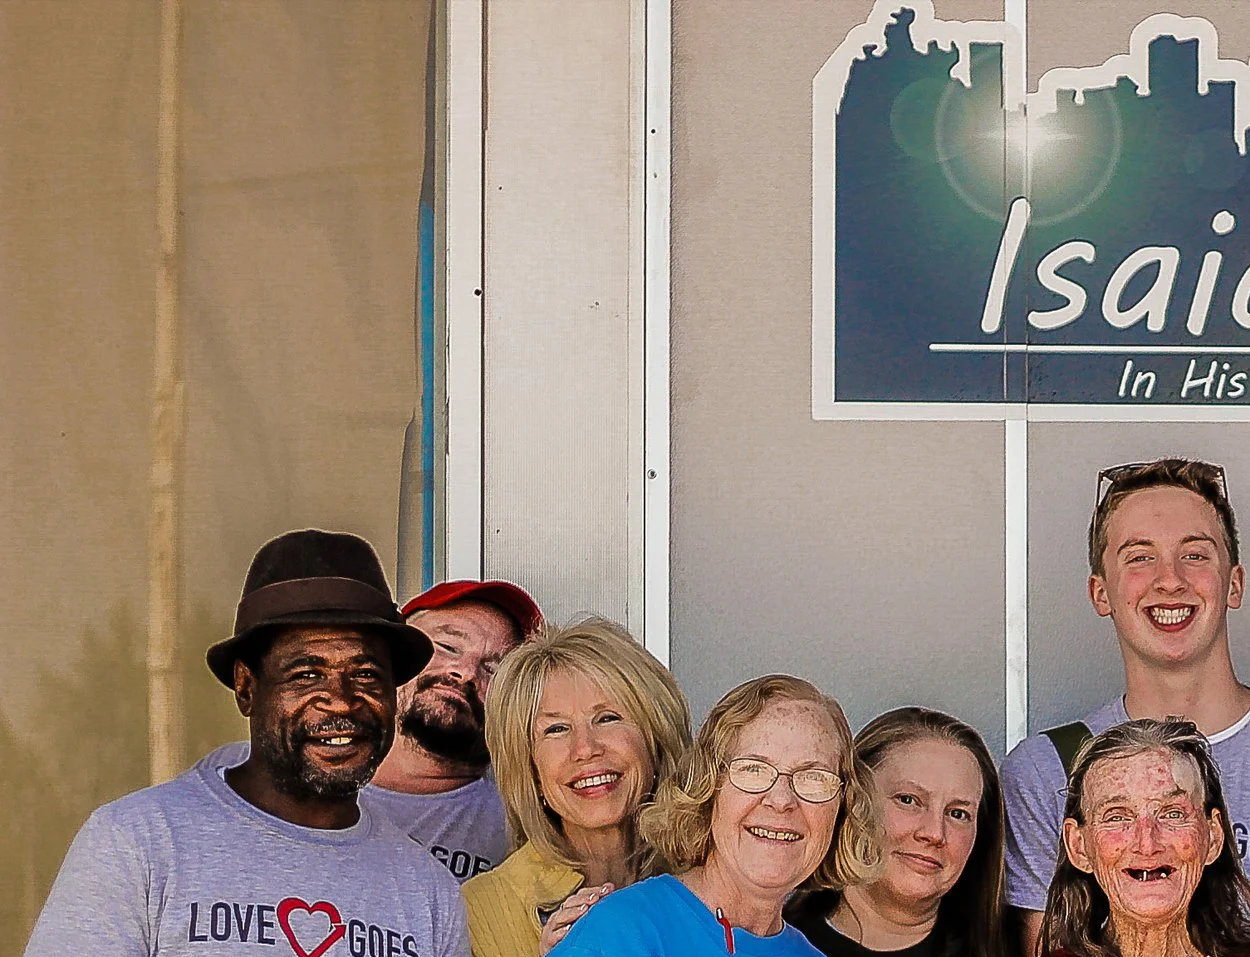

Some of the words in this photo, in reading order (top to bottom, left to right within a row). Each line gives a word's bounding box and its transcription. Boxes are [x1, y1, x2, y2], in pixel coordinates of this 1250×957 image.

[1117, 359, 1157, 399] In
[1180, 359, 1247, 400] His
[431, 845, 495, 879] GOE
[188, 901, 277, 946] LOVE
